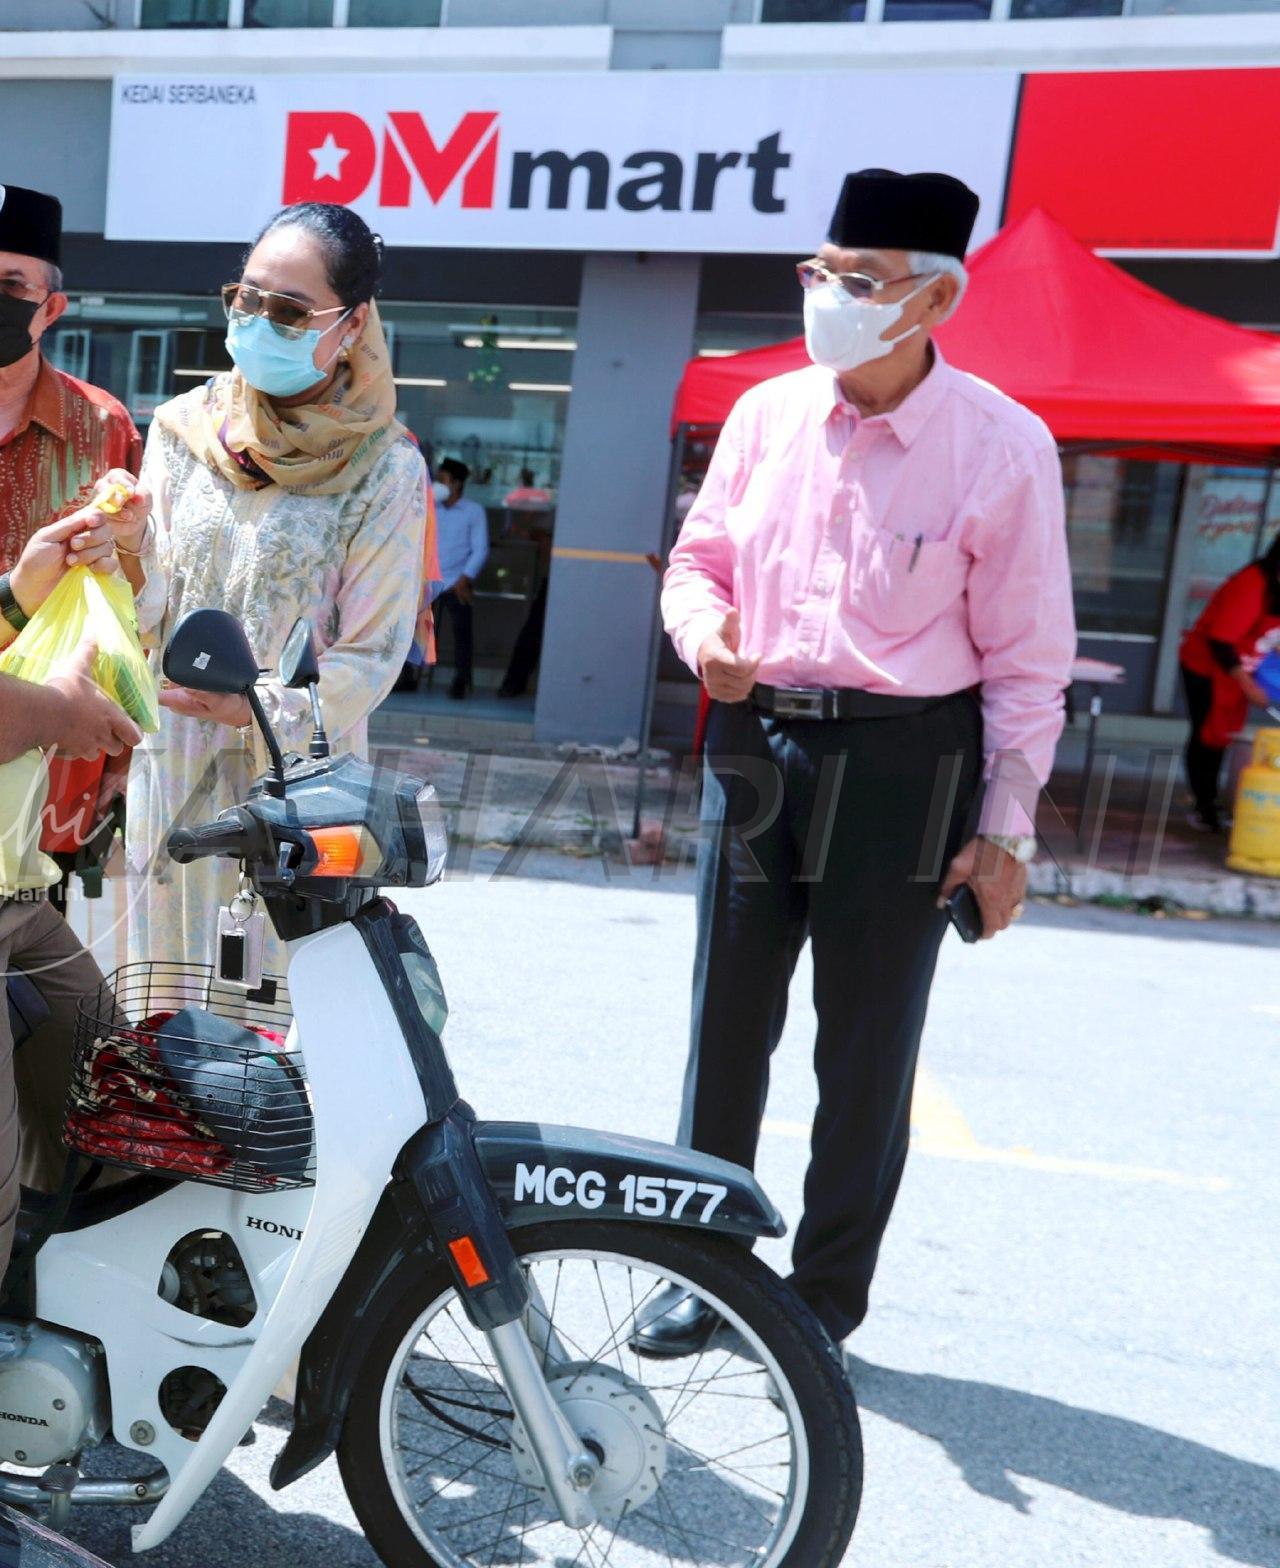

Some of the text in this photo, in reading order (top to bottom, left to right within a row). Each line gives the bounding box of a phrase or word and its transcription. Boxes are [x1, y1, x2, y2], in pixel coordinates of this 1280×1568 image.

[122, 84, 256, 104] KEDAI SERBANEKA
[514, 1162, 728, 1224] MCG 1577
[245, 1215, 305, 1241] HON
